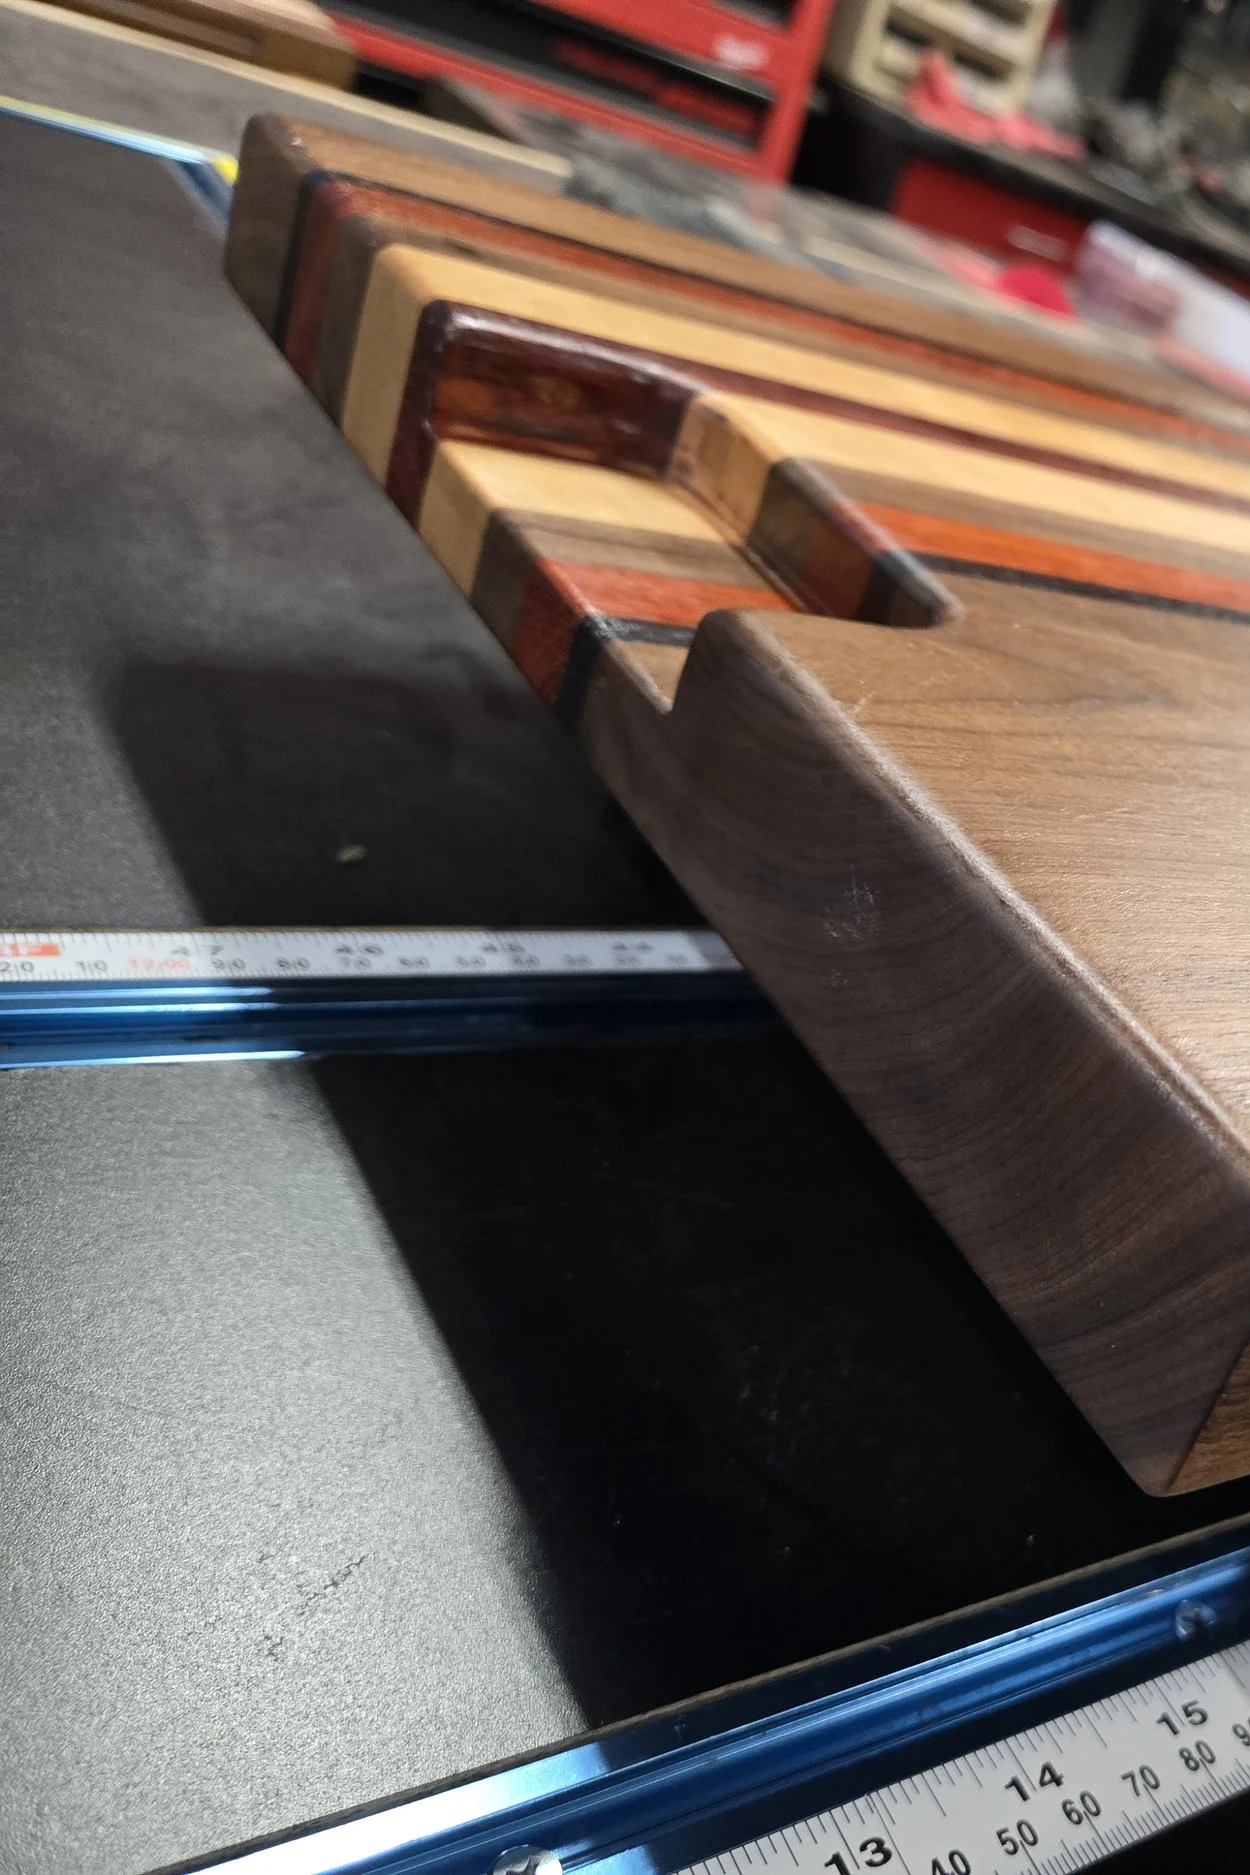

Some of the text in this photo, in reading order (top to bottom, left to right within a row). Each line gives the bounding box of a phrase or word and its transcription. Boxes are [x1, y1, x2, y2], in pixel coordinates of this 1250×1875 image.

[824, 1836, 893, 1875] 13
[1004, 1760, 1065, 1802] 14
[1156, 1700, 1209, 1737] 15
[930, 1849, 972, 1875] 40
[995, 1818, 1039, 1856] 50
[1060, 1790, 1103, 1826] 60
[1121, 1764, 1161, 1798] 70
[1178, 1739, 1217, 1772] 80
